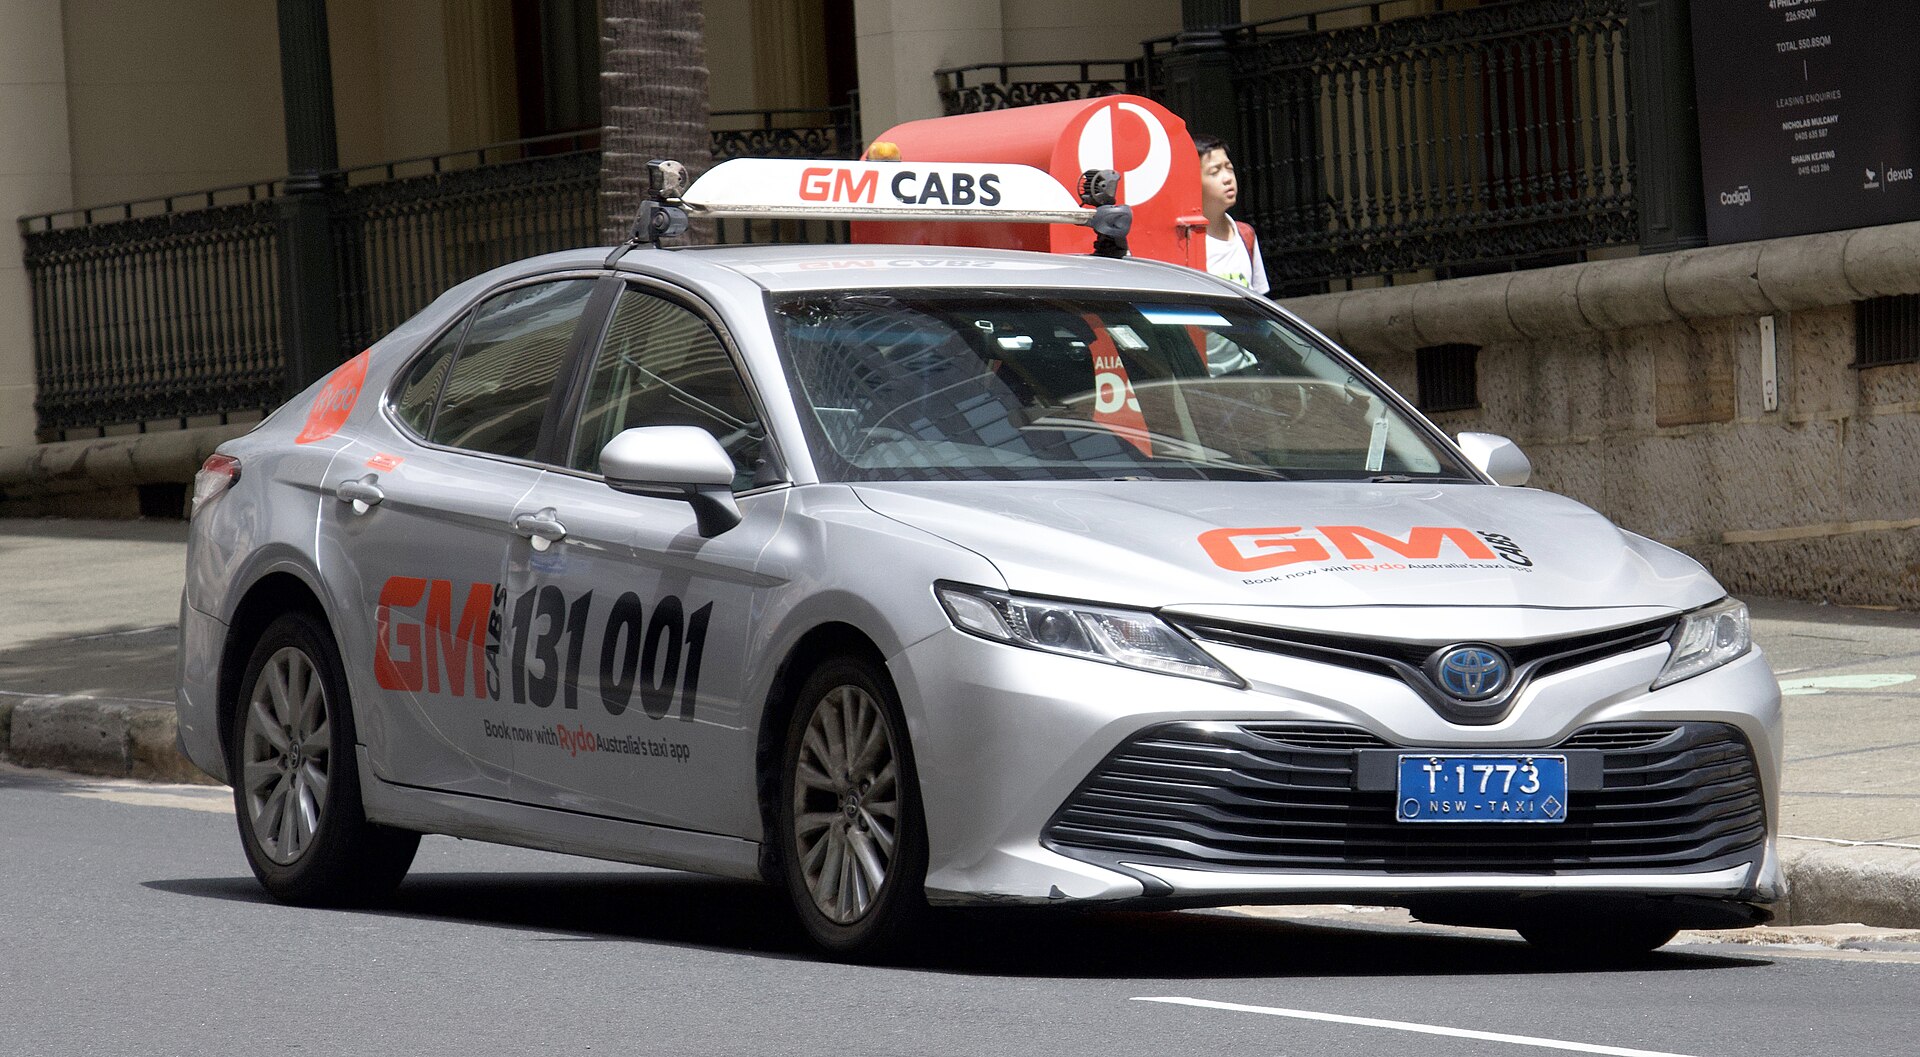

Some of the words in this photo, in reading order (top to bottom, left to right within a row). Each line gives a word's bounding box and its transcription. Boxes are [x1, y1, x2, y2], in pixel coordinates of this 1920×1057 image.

[1776, 41, 1798, 53] TOTAL
[1776, 96, 1804, 108] LEASING
[1806, 90, 1841, 103] ENQUIRIES
[1782, 119, 1811, 130] NICHOLAS
[1811, 115, 1839, 126] MULCAHY
[1791, 154, 1811, 164] SHAUN
[1887, 168, 1913, 182] dexus
[799, 167, 879, 203] GM
[891, 171, 1002, 206] CABS
[1197, 526, 1497, 572] GM
[1476, 530, 1533, 567] CABS
[1242, 575, 1282, 585] Book
[1286, 569, 1317, 579] now
[1320, 565, 1354, 573] with
[1351, 562, 1406, 572] Rydo
[1506, 564, 1533, 573] app
[374, 576, 494, 699] GM
[486, 583, 507, 701] CABS
[511, 584, 594, 710] 131
[600, 591, 714, 723] 001
[484, 719, 512, 740] Book
[512, 728, 533, 743] now
[534, 726, 558, 746] with
[557, 724, 597, 757] Rydo
[597, 733, 647, 756] Australia's
[648, 738, 669, 757] taxi
[670, 744, 690, 763] app
